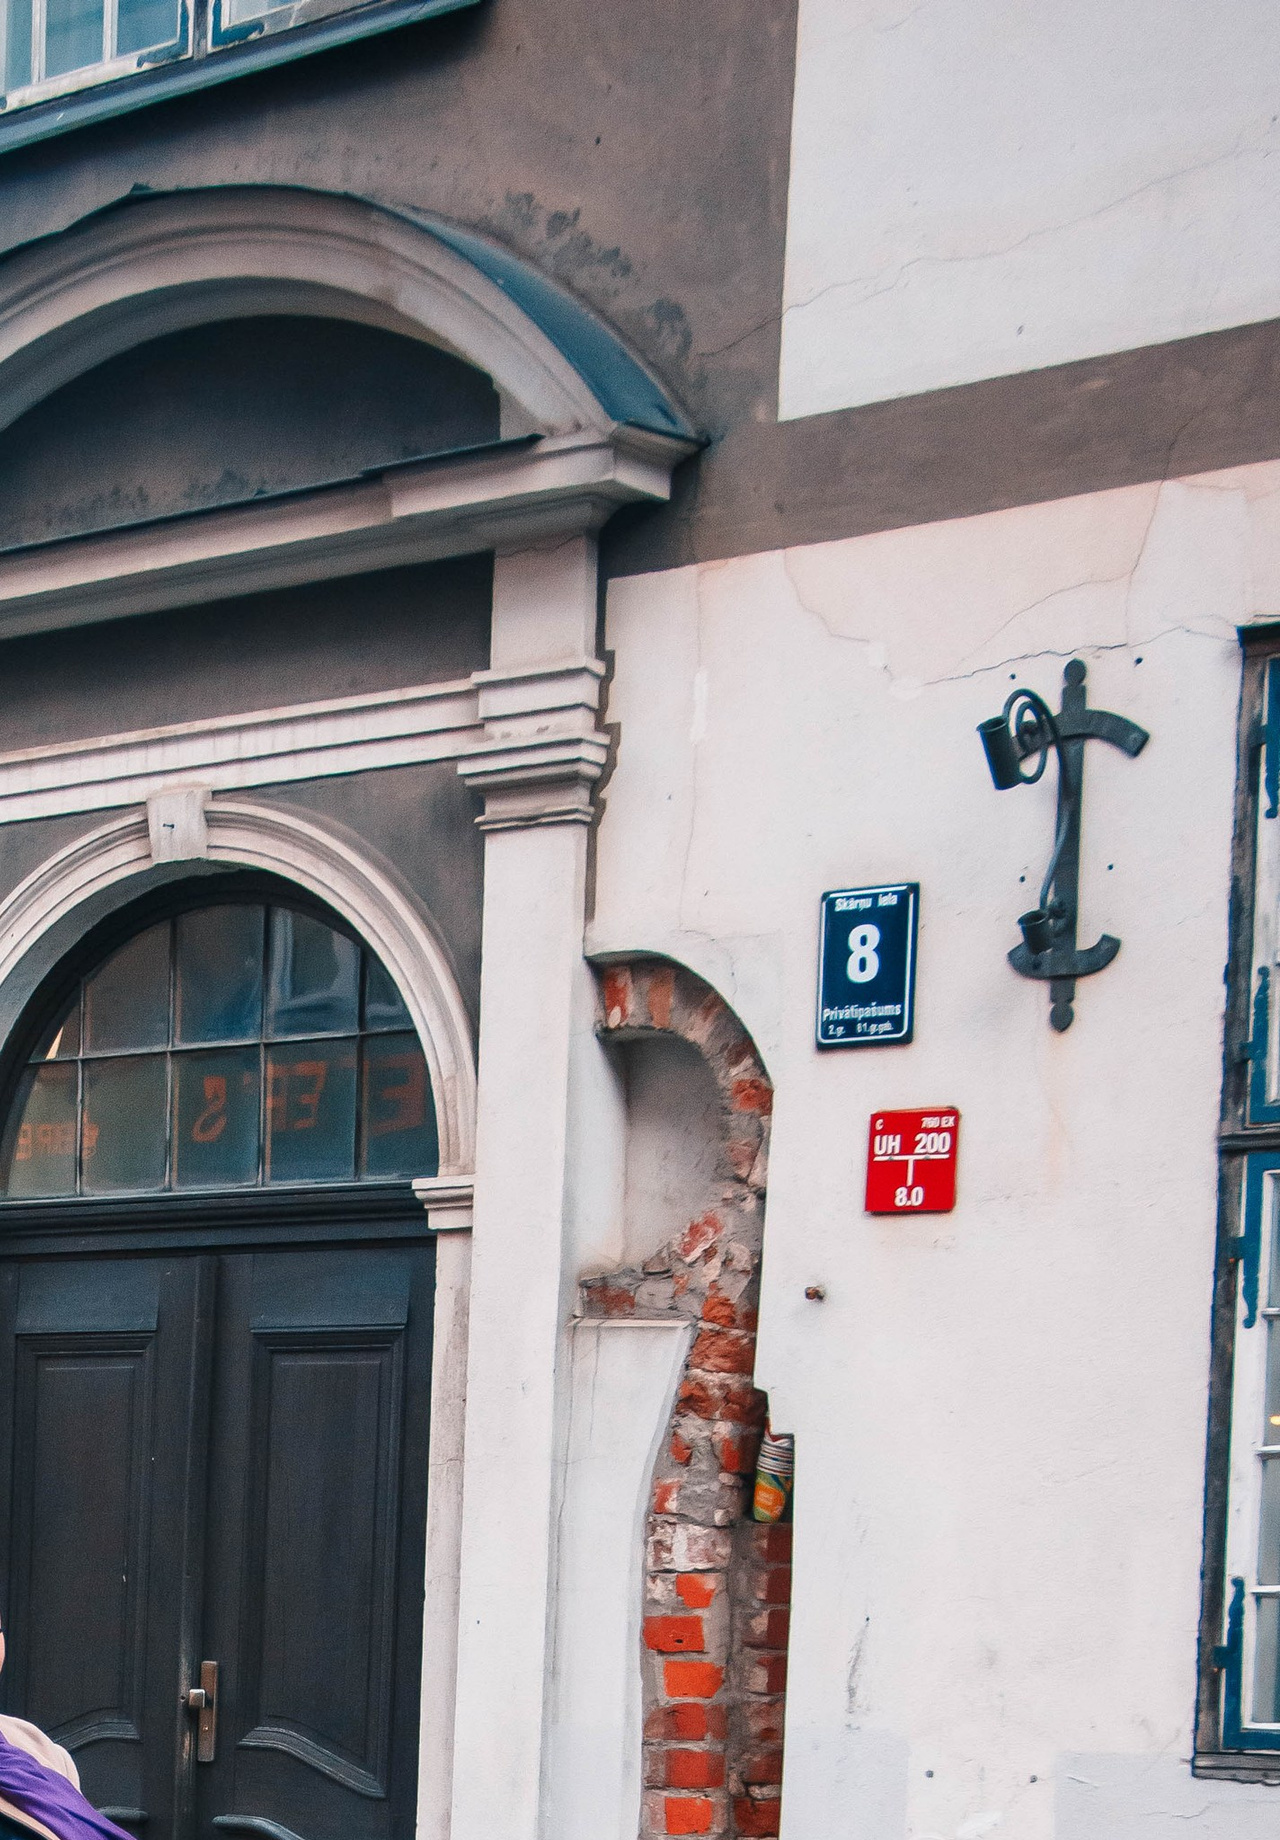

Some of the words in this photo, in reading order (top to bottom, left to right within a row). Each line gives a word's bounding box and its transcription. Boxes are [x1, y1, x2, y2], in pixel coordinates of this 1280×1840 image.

[877, 892, 898, 907] iela
[846, 923, 881, 984] 8
[873, 1134, 902, 1155] UH
[913, 1131, 951, 1154] 200
[893, 1186, 924, 1207] 8.0
